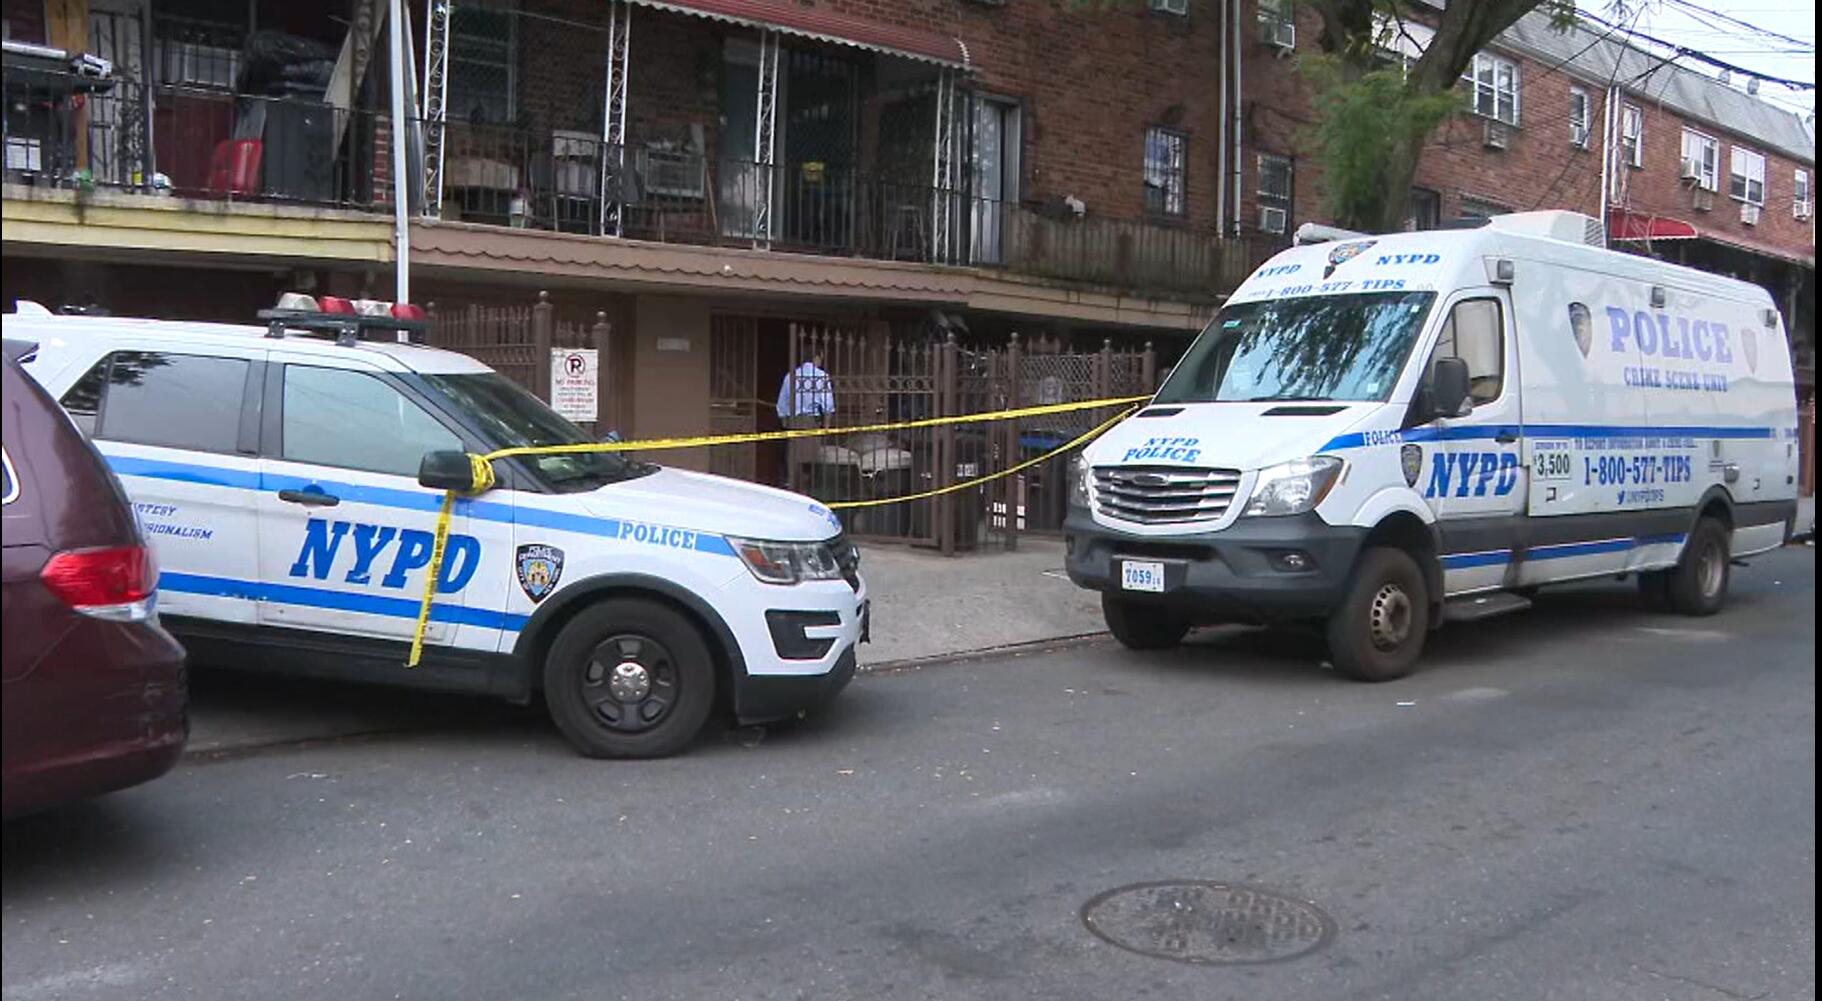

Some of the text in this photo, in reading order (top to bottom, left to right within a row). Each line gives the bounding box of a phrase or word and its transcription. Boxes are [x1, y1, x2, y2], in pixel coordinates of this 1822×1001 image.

[1255, 264, 1302, 278] NYPD
[1376, 255, 1440, 266] NYPD
[1606, 306, 1733, 363] POLICE
[1624, 366, 1728, 392] CRIME SCENE UNIT
[1144, 438, 1199, 447] NYPD
[1122, 447, 1201, 462] POLICE
[1425, 453, 1518, 498] NYPD
[1584, 455, 1691, 485] 1-800-577-TIPS
[145, 523, 213, 539] SIONALISM
[620, 521, 695, 549] POLICE
[289, 517, 481, 594] NYPD
[1125, 568, 1151, 584] 7059
